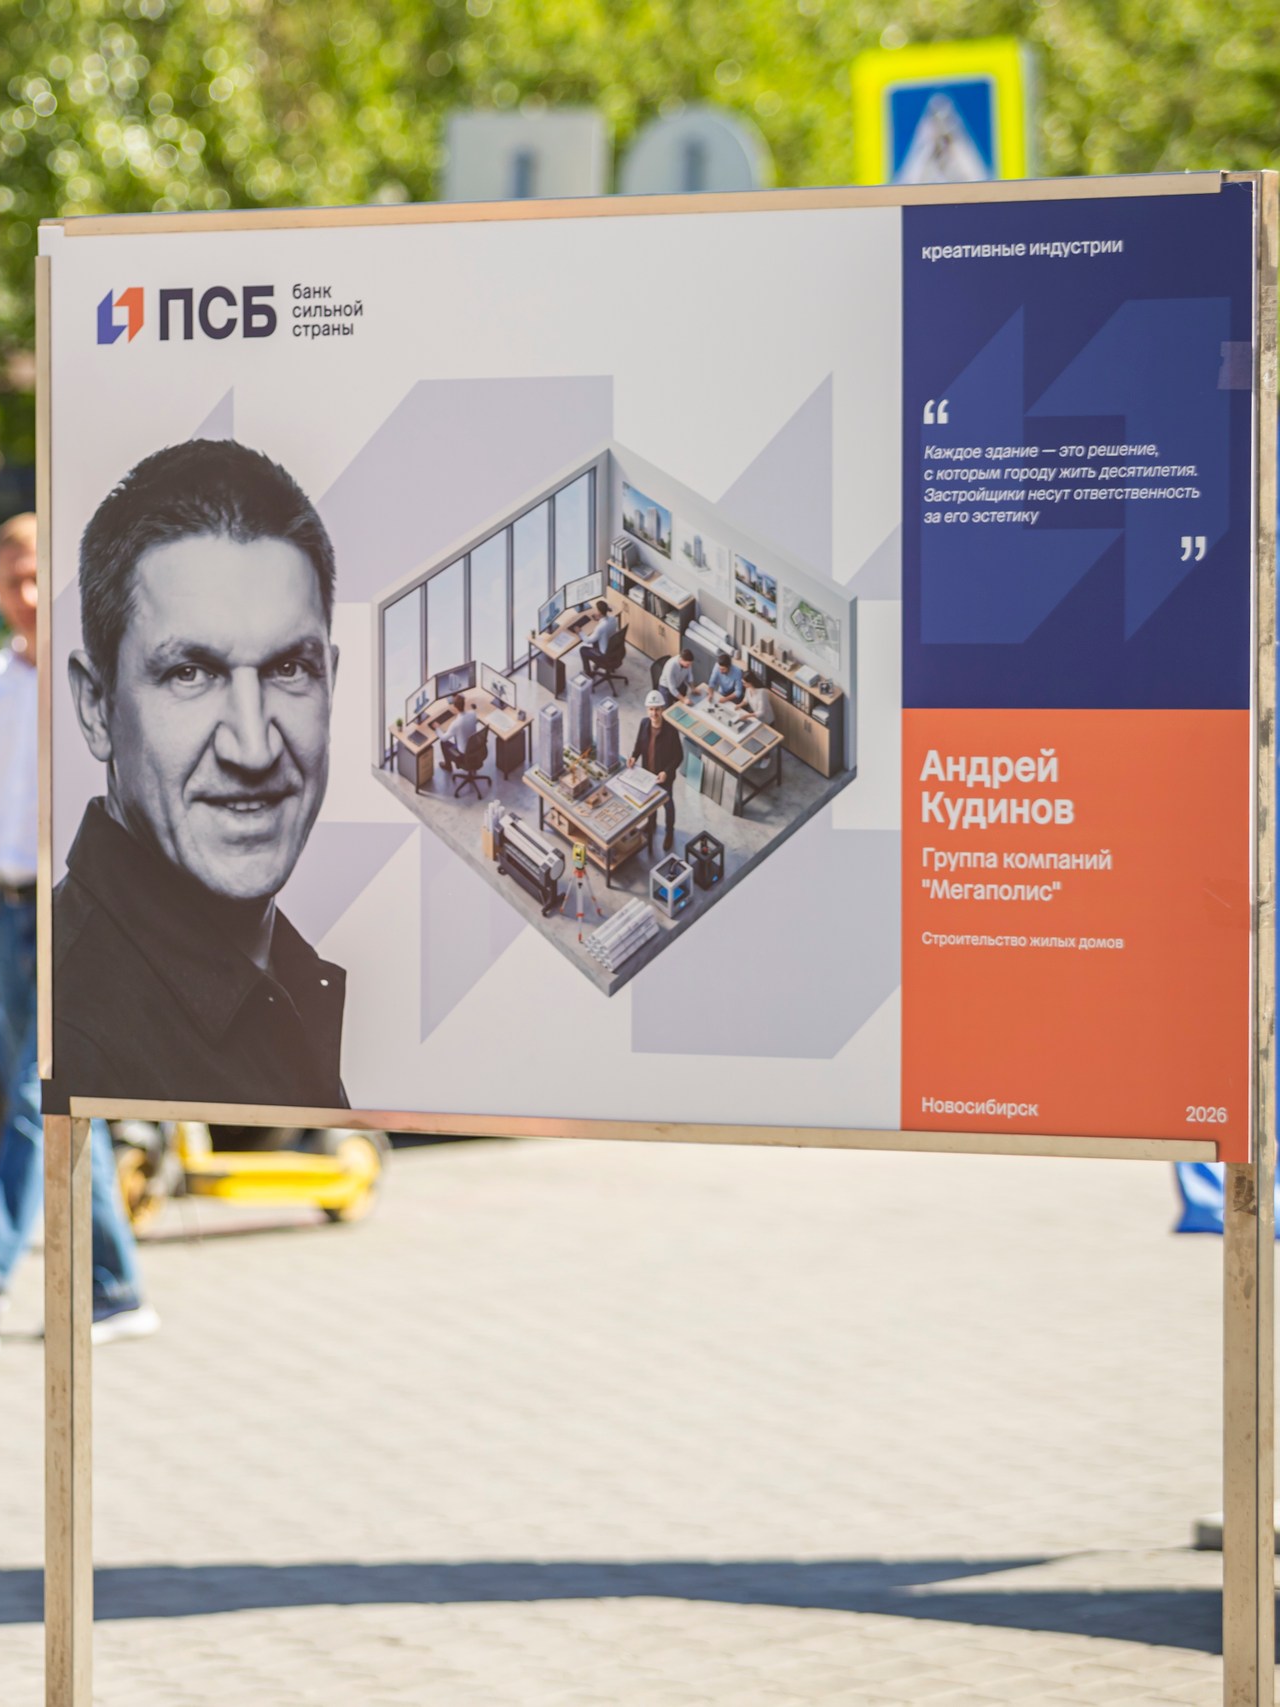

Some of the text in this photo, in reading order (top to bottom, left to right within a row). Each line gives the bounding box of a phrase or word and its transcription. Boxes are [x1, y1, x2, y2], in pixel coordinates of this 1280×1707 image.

[922, 240, 1123, 262] креативные индустрии
[293, 283, 331, 299] банк
[160, 285, 277, 341] ПСБ
[293, 301, 363, 318] сильной
[293, 322, 353, 339] страны
[924, 446, 982, 461] Каждое
[985, 446, 1038, 460] здание
[1059, 445, 1084, 457] это
[1087, 444, 1158, 459] решение,
[924, 466, 1197, 482] с которым городу жить десятилетия.
[924, 487, 1200, 504] Застройщики несут ответственность
[924, 511, 1039, 524] за его эстетику
[919, 748, 1058, 789] Андрей
[922, 791, 1074, 830] Кудинов
[923, 847, 1112, 872] Группа компаний
[922, 879, 1061, 901] "Мегаполис"
[922, 932, 1124, 950] Строительство жилых домов
[922, 1097, 1038, 1118] Новосибирск
[1186, 1106, 1227, 1123] 2026
